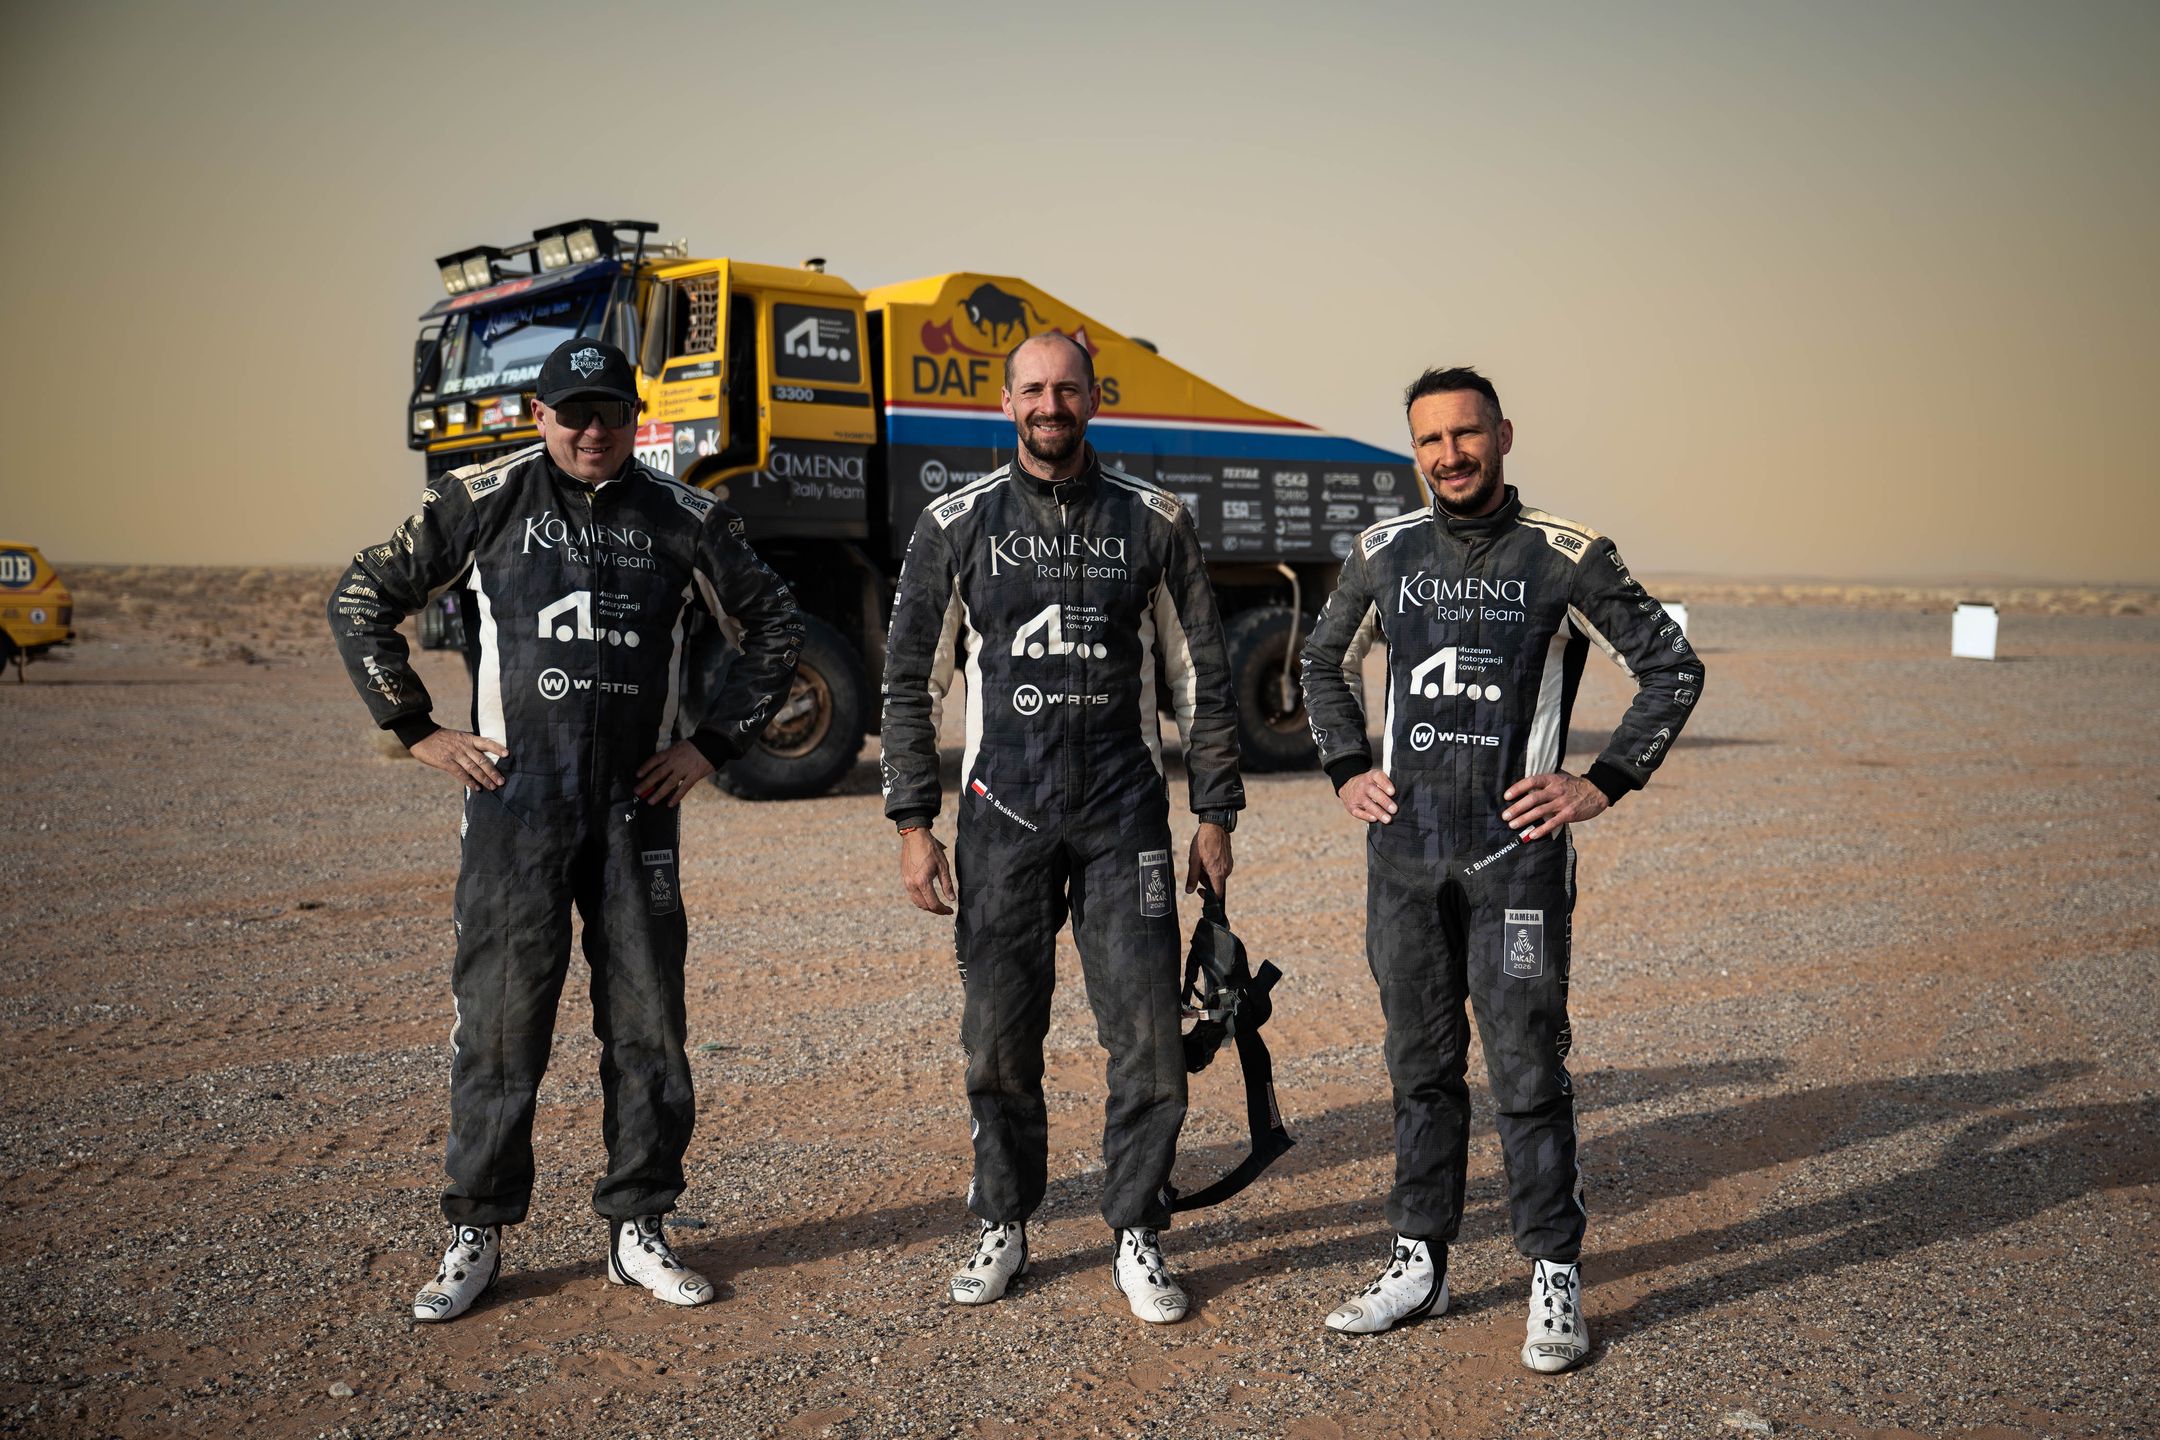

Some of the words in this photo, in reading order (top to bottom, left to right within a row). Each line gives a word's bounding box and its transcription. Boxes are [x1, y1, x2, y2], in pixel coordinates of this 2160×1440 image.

[502, 364, 541, 384] TRAN
[912, 355, 991, 397] DAF
[776, 386, 815, 402] 3300
[472, 475, 499, 492] OMP
[794, 482, 825, 500] Rally
[827, 484, 865, 500] Team
[682, 497, 708, 512] OMP
[940, 502, 966, 518] OMP
[1150, 496, 1175, 513] OMP
[1365, 532, 1388, 549] OMP
[1554, 535, 1583, 551] OMP
[610, 551, 656, 570] Team
[1037, 564, 1079, 580] Rally
[1082, 564, 1127, 580] Team
[1438, 606, 1475, 623] Rally
[1479, 607, 1525, 623] Team
[1458, 646, 1492, 655] Muzeum
[1458, 655, 1503, 665] Motoryzacji
[1458, 664, 1487, 673] Kowary
[573, 679, 640, 695] WATIS
[1046, 693, 1110, 706] WATIS
[1438, 731, 1500, 747] WATIS
[986, 792, 994, 803] D.
[994, 799, 1039, 832] Baśkiewicz
[644, 852, 671, 862] KAMENA
[1463, 867, 1474, 876] T.
[1509, 912, 1540, 922] KAMENA
[1160, 1296, 1188, 1306] OM
[1536, 1344, 1582, 1358] OMP
